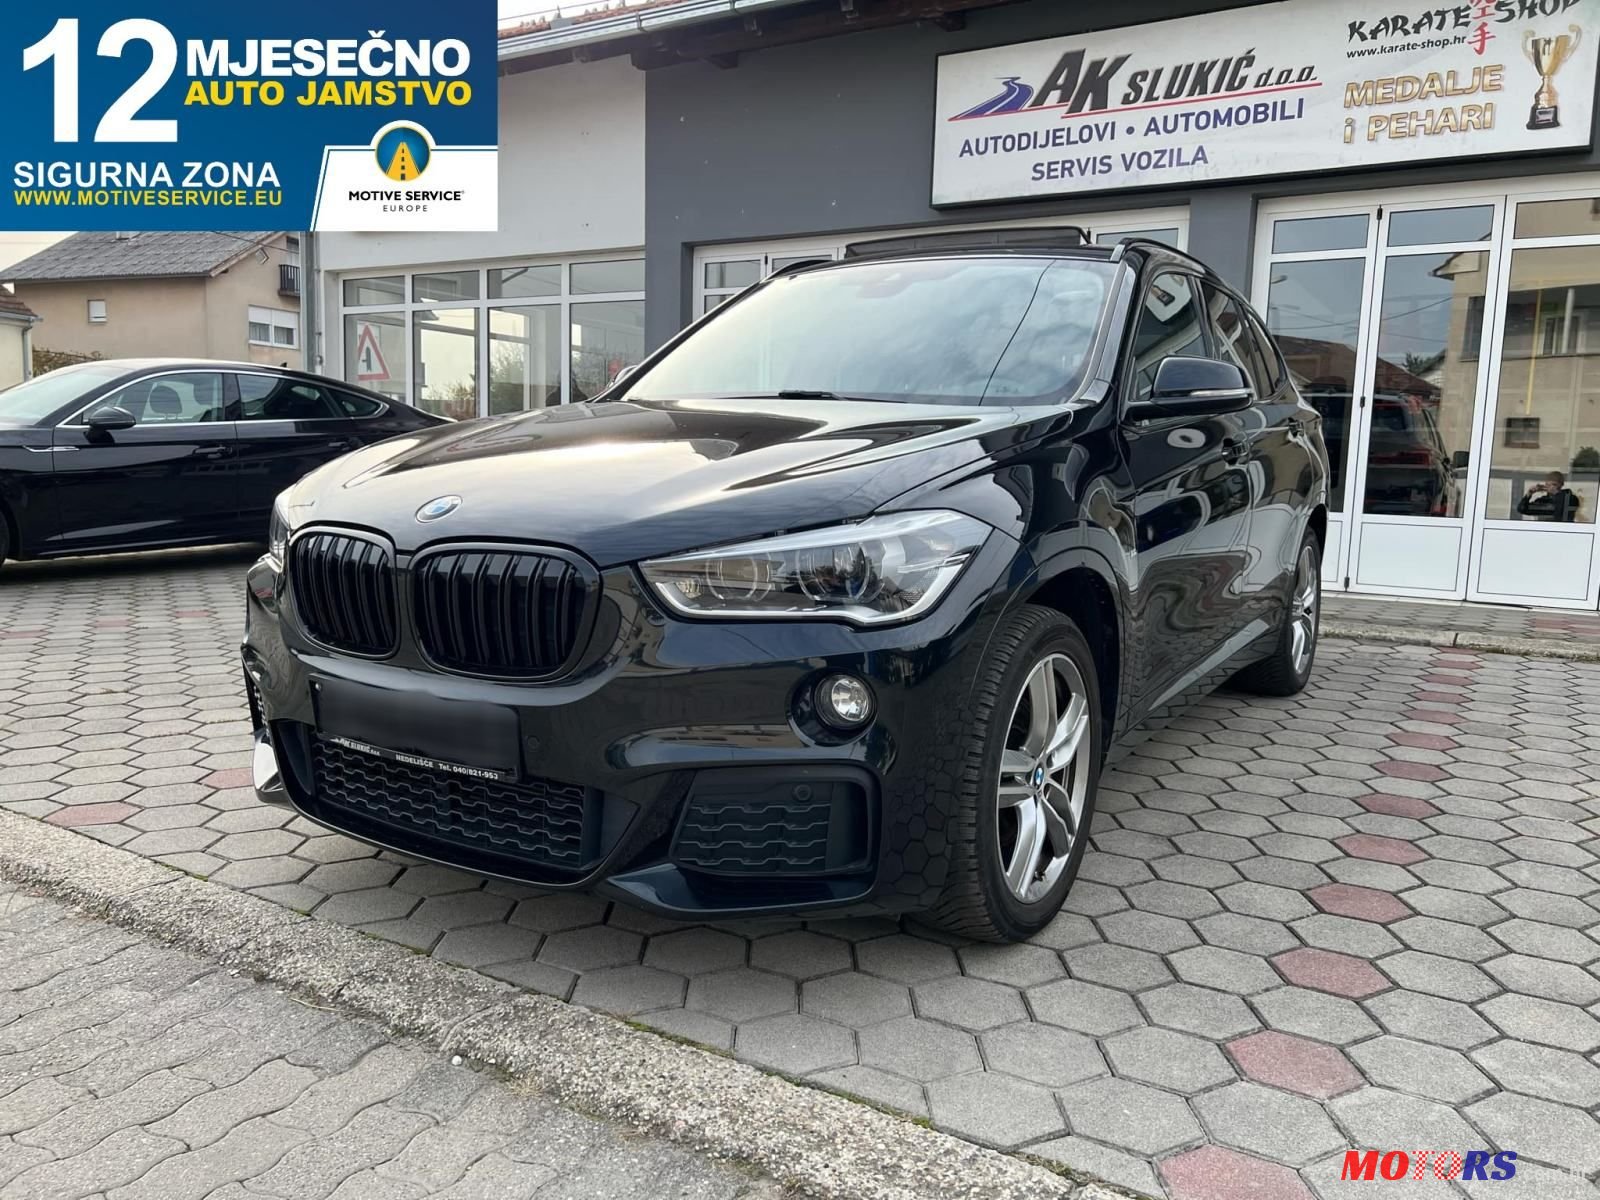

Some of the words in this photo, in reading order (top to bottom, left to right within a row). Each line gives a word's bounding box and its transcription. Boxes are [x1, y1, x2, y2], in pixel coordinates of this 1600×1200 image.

[1348, 5, 1472, 43] KARATE
[1346, 35, 1466, 59] www.karate-shop.hr
[1027, 48, 1133, 115] AK
[1121, 47, 1257, 106] SLUKIĆ
[1344, 64, 1505, 109] MEDALJE
[959, 121, 1116, 158] AUTODIJELOVI
[1143, 98, 1304, 137] AUTOMOBILI
[1343, 118, 1355, 144] i
[1367, 102, 1496, 141] PEHARI
[1031, 155, 1112, 182] SERVIS
[1120, 145, 1209, 172] VOZILA
